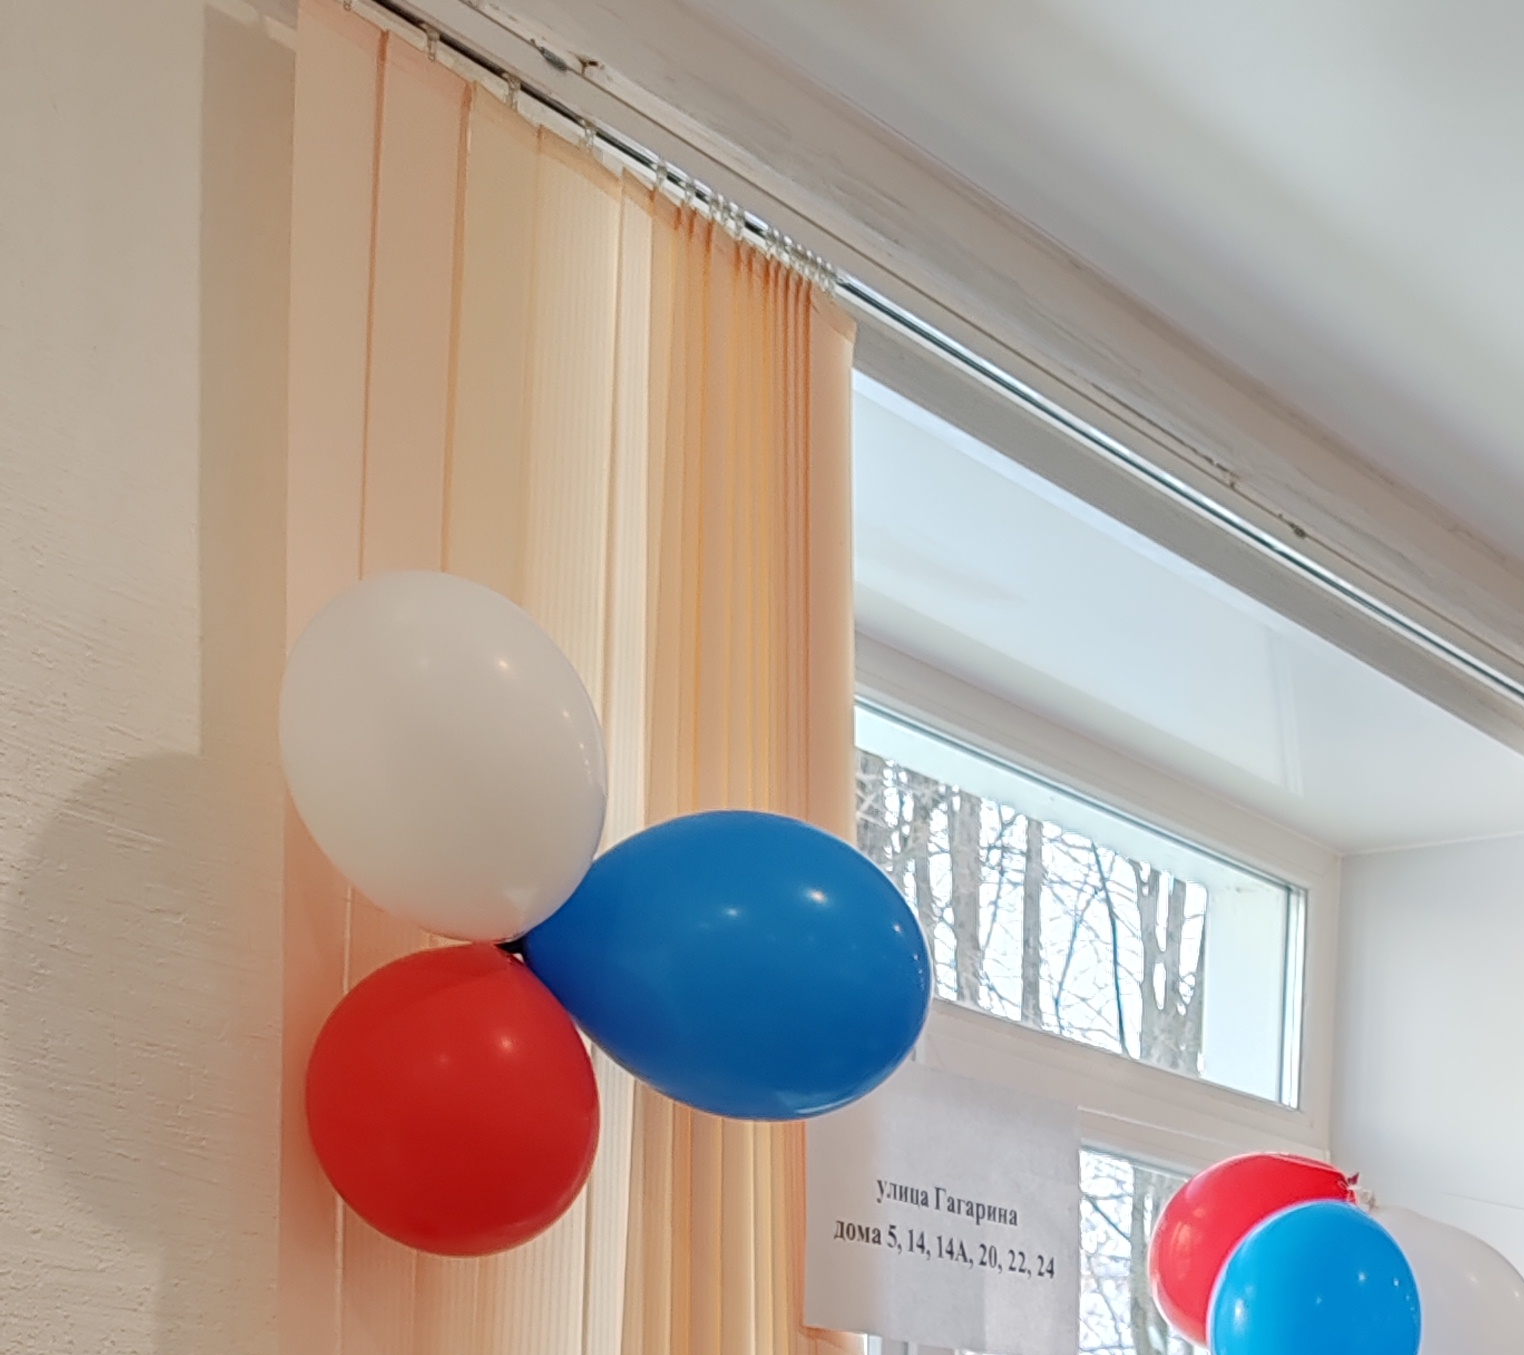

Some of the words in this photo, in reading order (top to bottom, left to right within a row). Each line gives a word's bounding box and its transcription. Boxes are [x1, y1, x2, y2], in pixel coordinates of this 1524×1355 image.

[876, 1178, 929, 1207] улица
[934, 1186, 1018, 1226] Гагарина
[833, 1220, 882, 1245] дома
[887, 1224, 902, 1253] 5,
[907, 1229, 931, 1260] 14,
[937, 1235, 974, 1269] 14А,
[979, 1244, 1003, 1273] 20,
[1008, 1249, 1032, 1279] 22,
[1037, 1254, 1055, 1279] 24
